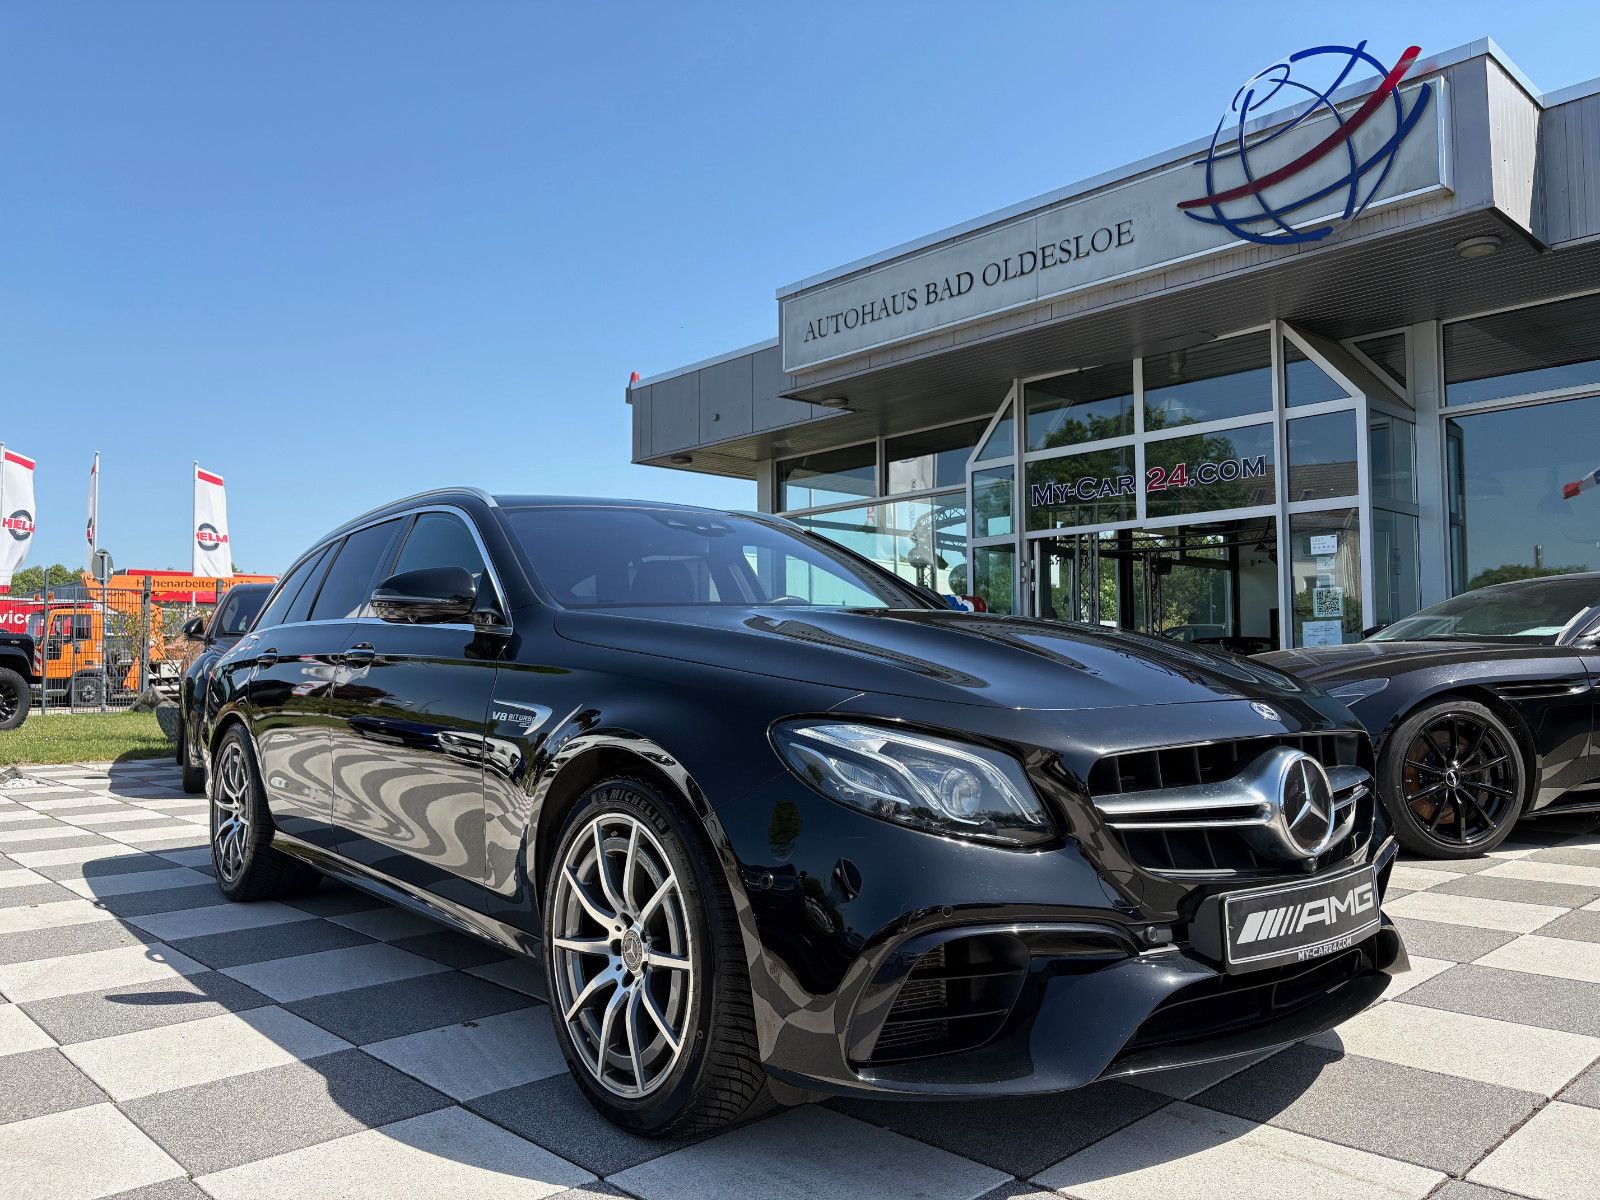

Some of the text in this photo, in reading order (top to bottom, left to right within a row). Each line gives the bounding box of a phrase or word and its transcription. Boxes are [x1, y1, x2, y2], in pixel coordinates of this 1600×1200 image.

[803, 219, 1135, 343] AUTOHAUS BAD OLDESLOE
[136, 579, 217, 588] Hhenarbeite
[492, 711, 508, 721] V8
[609, 788, 668, 832] MICHELIN
[1296, 881, 1374, 933] AMG
